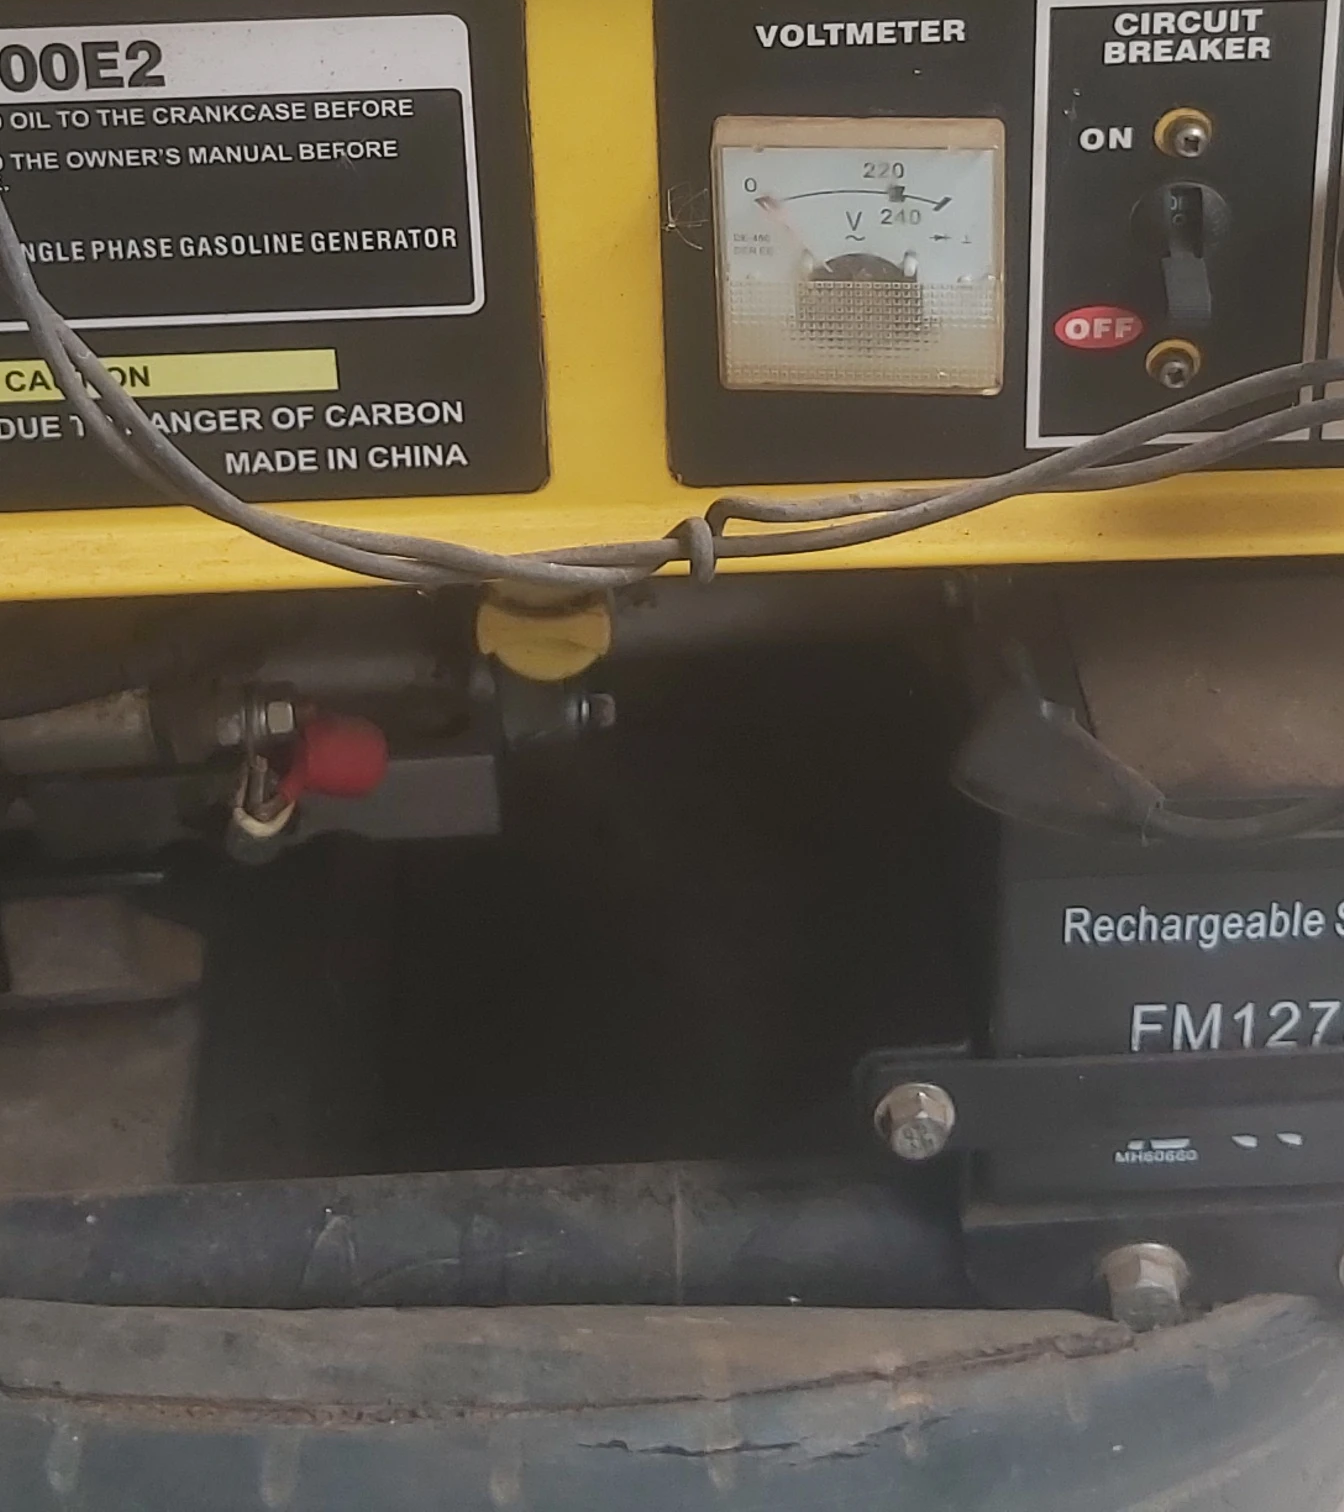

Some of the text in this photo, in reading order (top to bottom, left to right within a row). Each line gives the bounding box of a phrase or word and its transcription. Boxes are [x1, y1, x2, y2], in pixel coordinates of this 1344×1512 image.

[755, 18, 966, 48] VOLTMETER
[1113, 7, 1264, 37] CIRCUIT
[1102, 36, 1271, 65] BREAKER
[10, 111, 51, 130] OIL
[56, 108, 90, 129] TO
[97, 106, 146, 127] THE
[152, 101, 307, 125] CRANKCASE
[314, 98, 415, 120] BEFORE
[1079, 126, 1134, 152] ON
[10, 152, 59, 171] THE
[65, 148, 182, 169] OWNER'S
[188, 144, 293, 166] MANUAL
[299, 139, 399, 161] BEFORE
[862, 161, 905, 180] 220
[743, 178, 758, 194] 0
[845, 210, 863, 231] V
[880, 208, 922, 227] 240
[20, 227, 458, 264] NGLE PHASE GASOLINE GENERATOR
[1064, 316, 1135, 341] OFF
[5, 365, 151, 392] CAON
[126, 404, 263, 435] ANGER
[271, 405, 315, 429] OF
[324, 400, 464, 427] CARBON
[225, 443, 469, 475] MADE IN CHINA
[1062, 901, 1326, 949] Rechargeable
